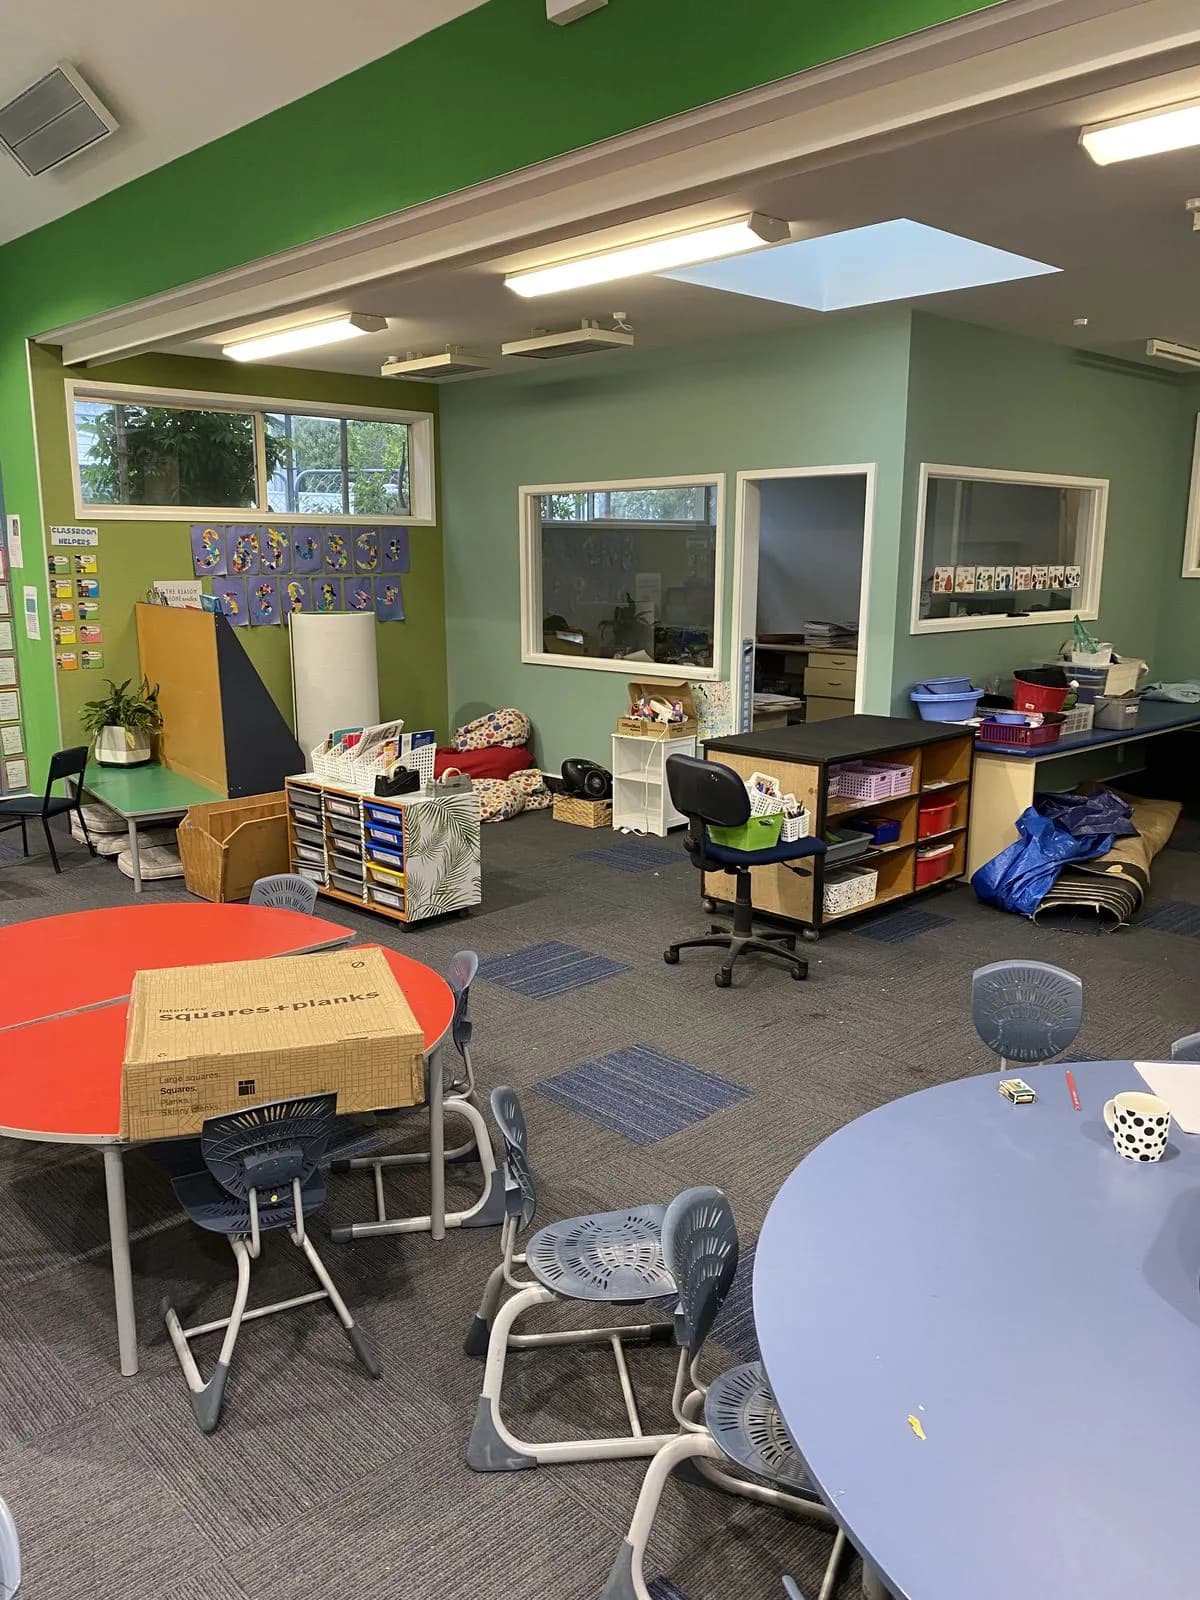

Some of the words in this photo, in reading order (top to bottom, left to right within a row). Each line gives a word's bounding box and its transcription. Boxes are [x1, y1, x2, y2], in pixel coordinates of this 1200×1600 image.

[52, 527, 96, 535] CLASSROOM
[159, 991, 380, 1022] squares+planks
[159, 1005, 207, 1013] Interface
[159, 1076, 183, 1085] Large
[160, 1086, 198, 1096] Squares.
[161, 1107, 190, 1117] Skinny
